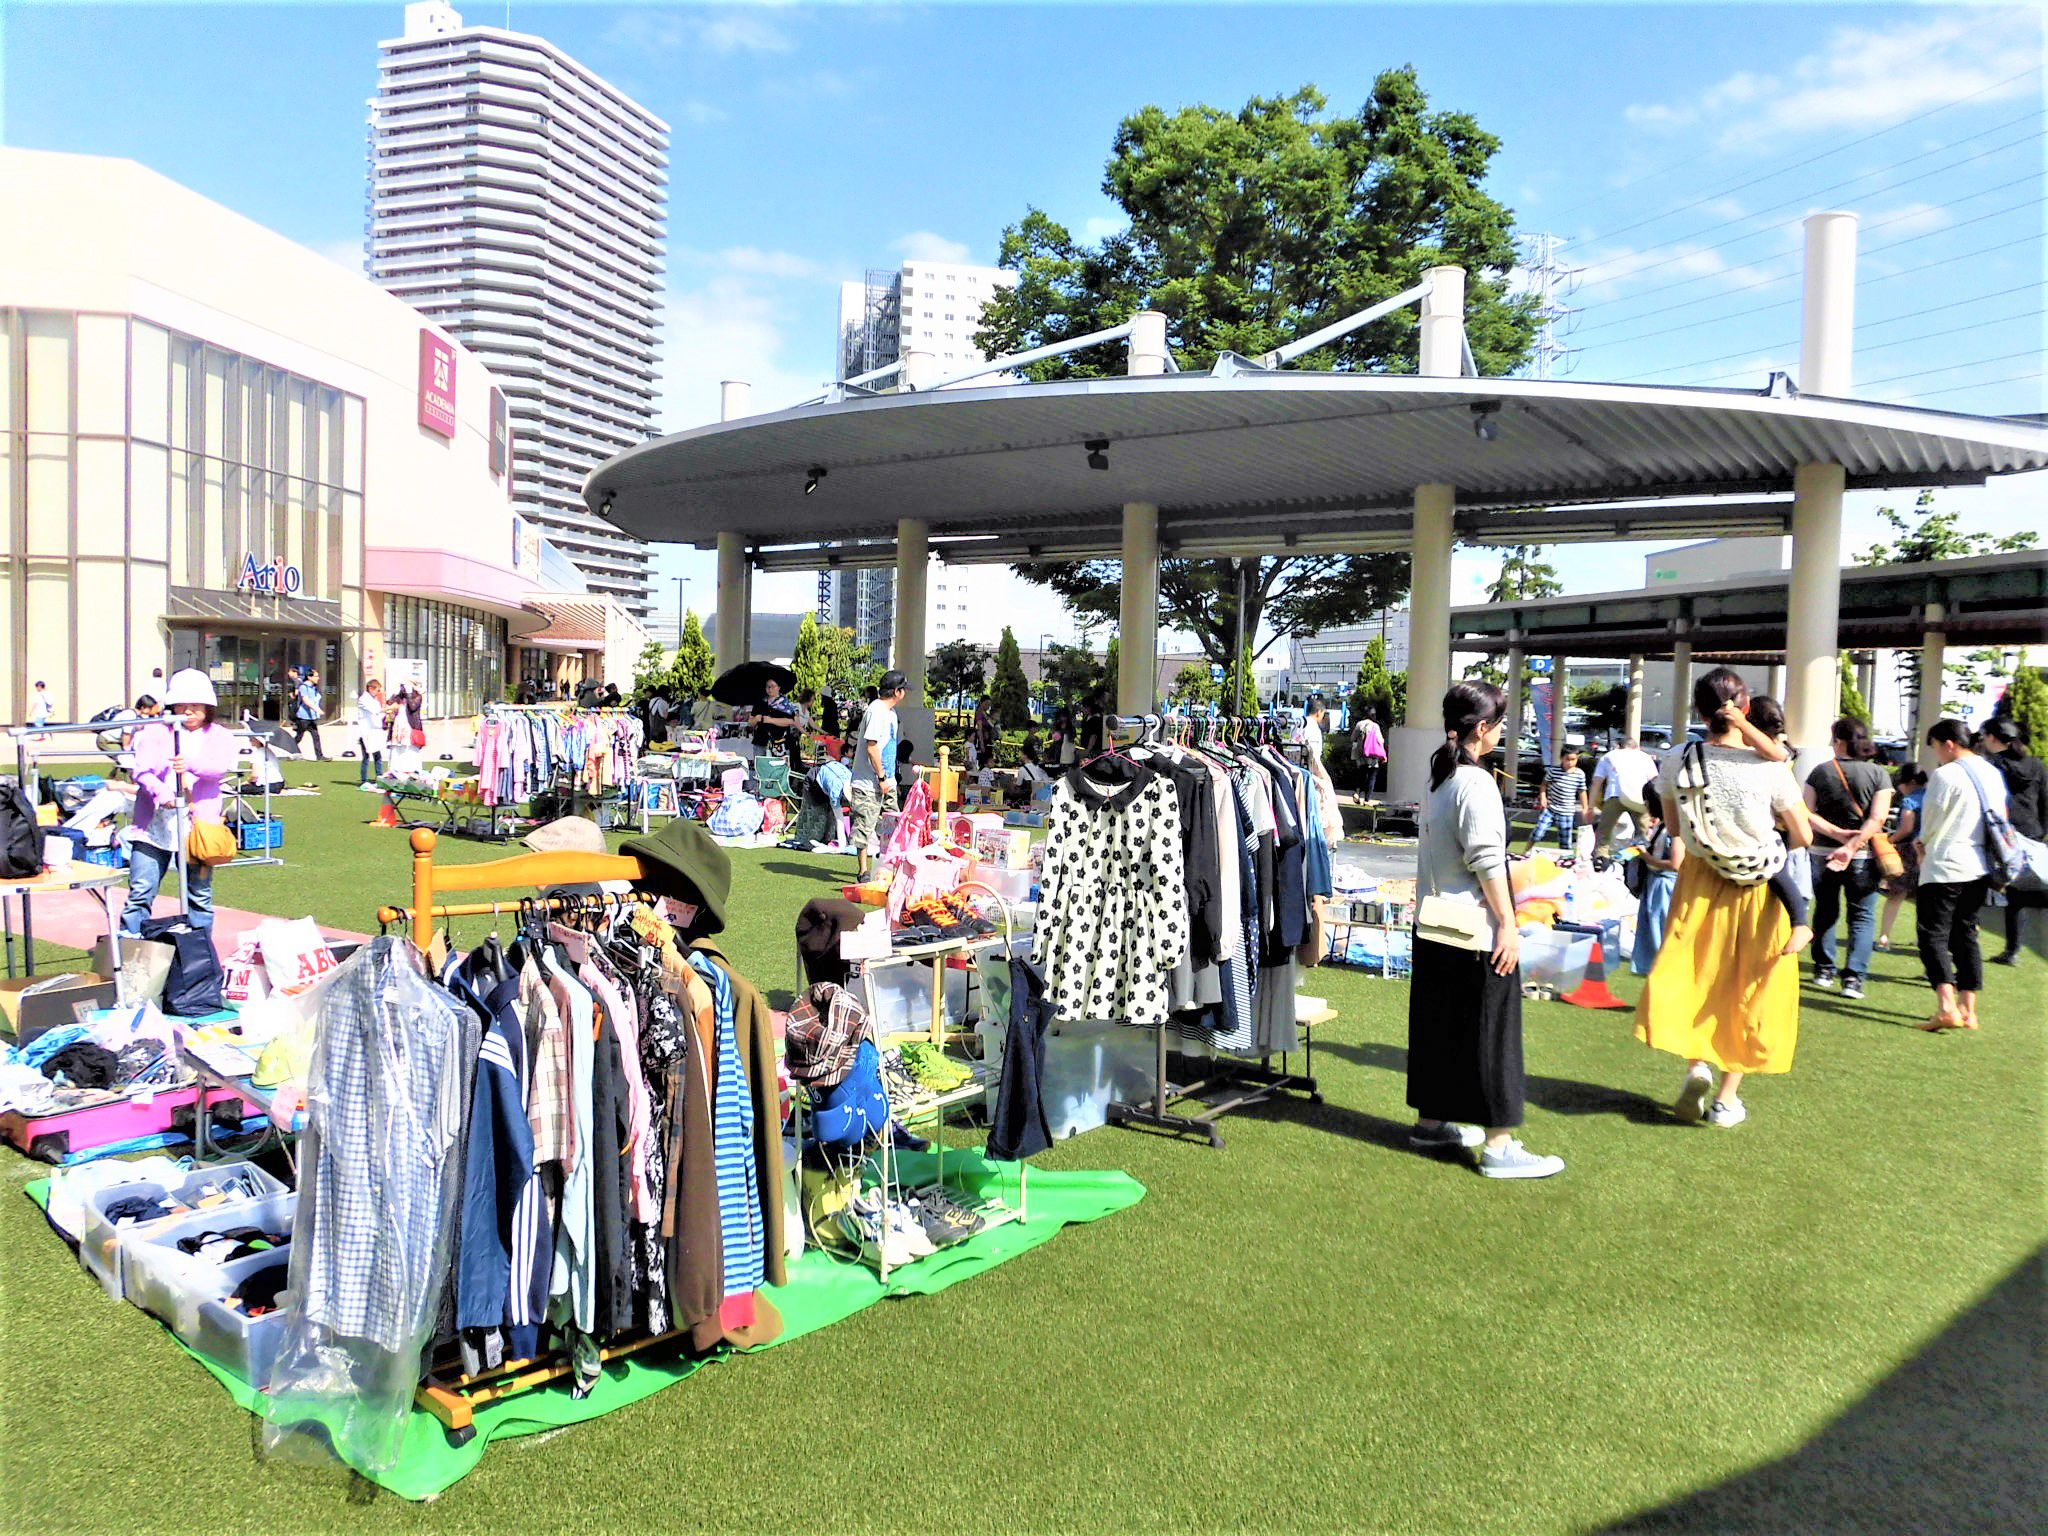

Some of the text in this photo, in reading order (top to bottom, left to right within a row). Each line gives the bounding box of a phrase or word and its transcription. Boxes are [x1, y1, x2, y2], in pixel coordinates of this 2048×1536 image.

[425, 389, 455, 415] ACADEMIA
[237, 551, 301, 594] Ario
[1535, 659, 1546, 669] D
